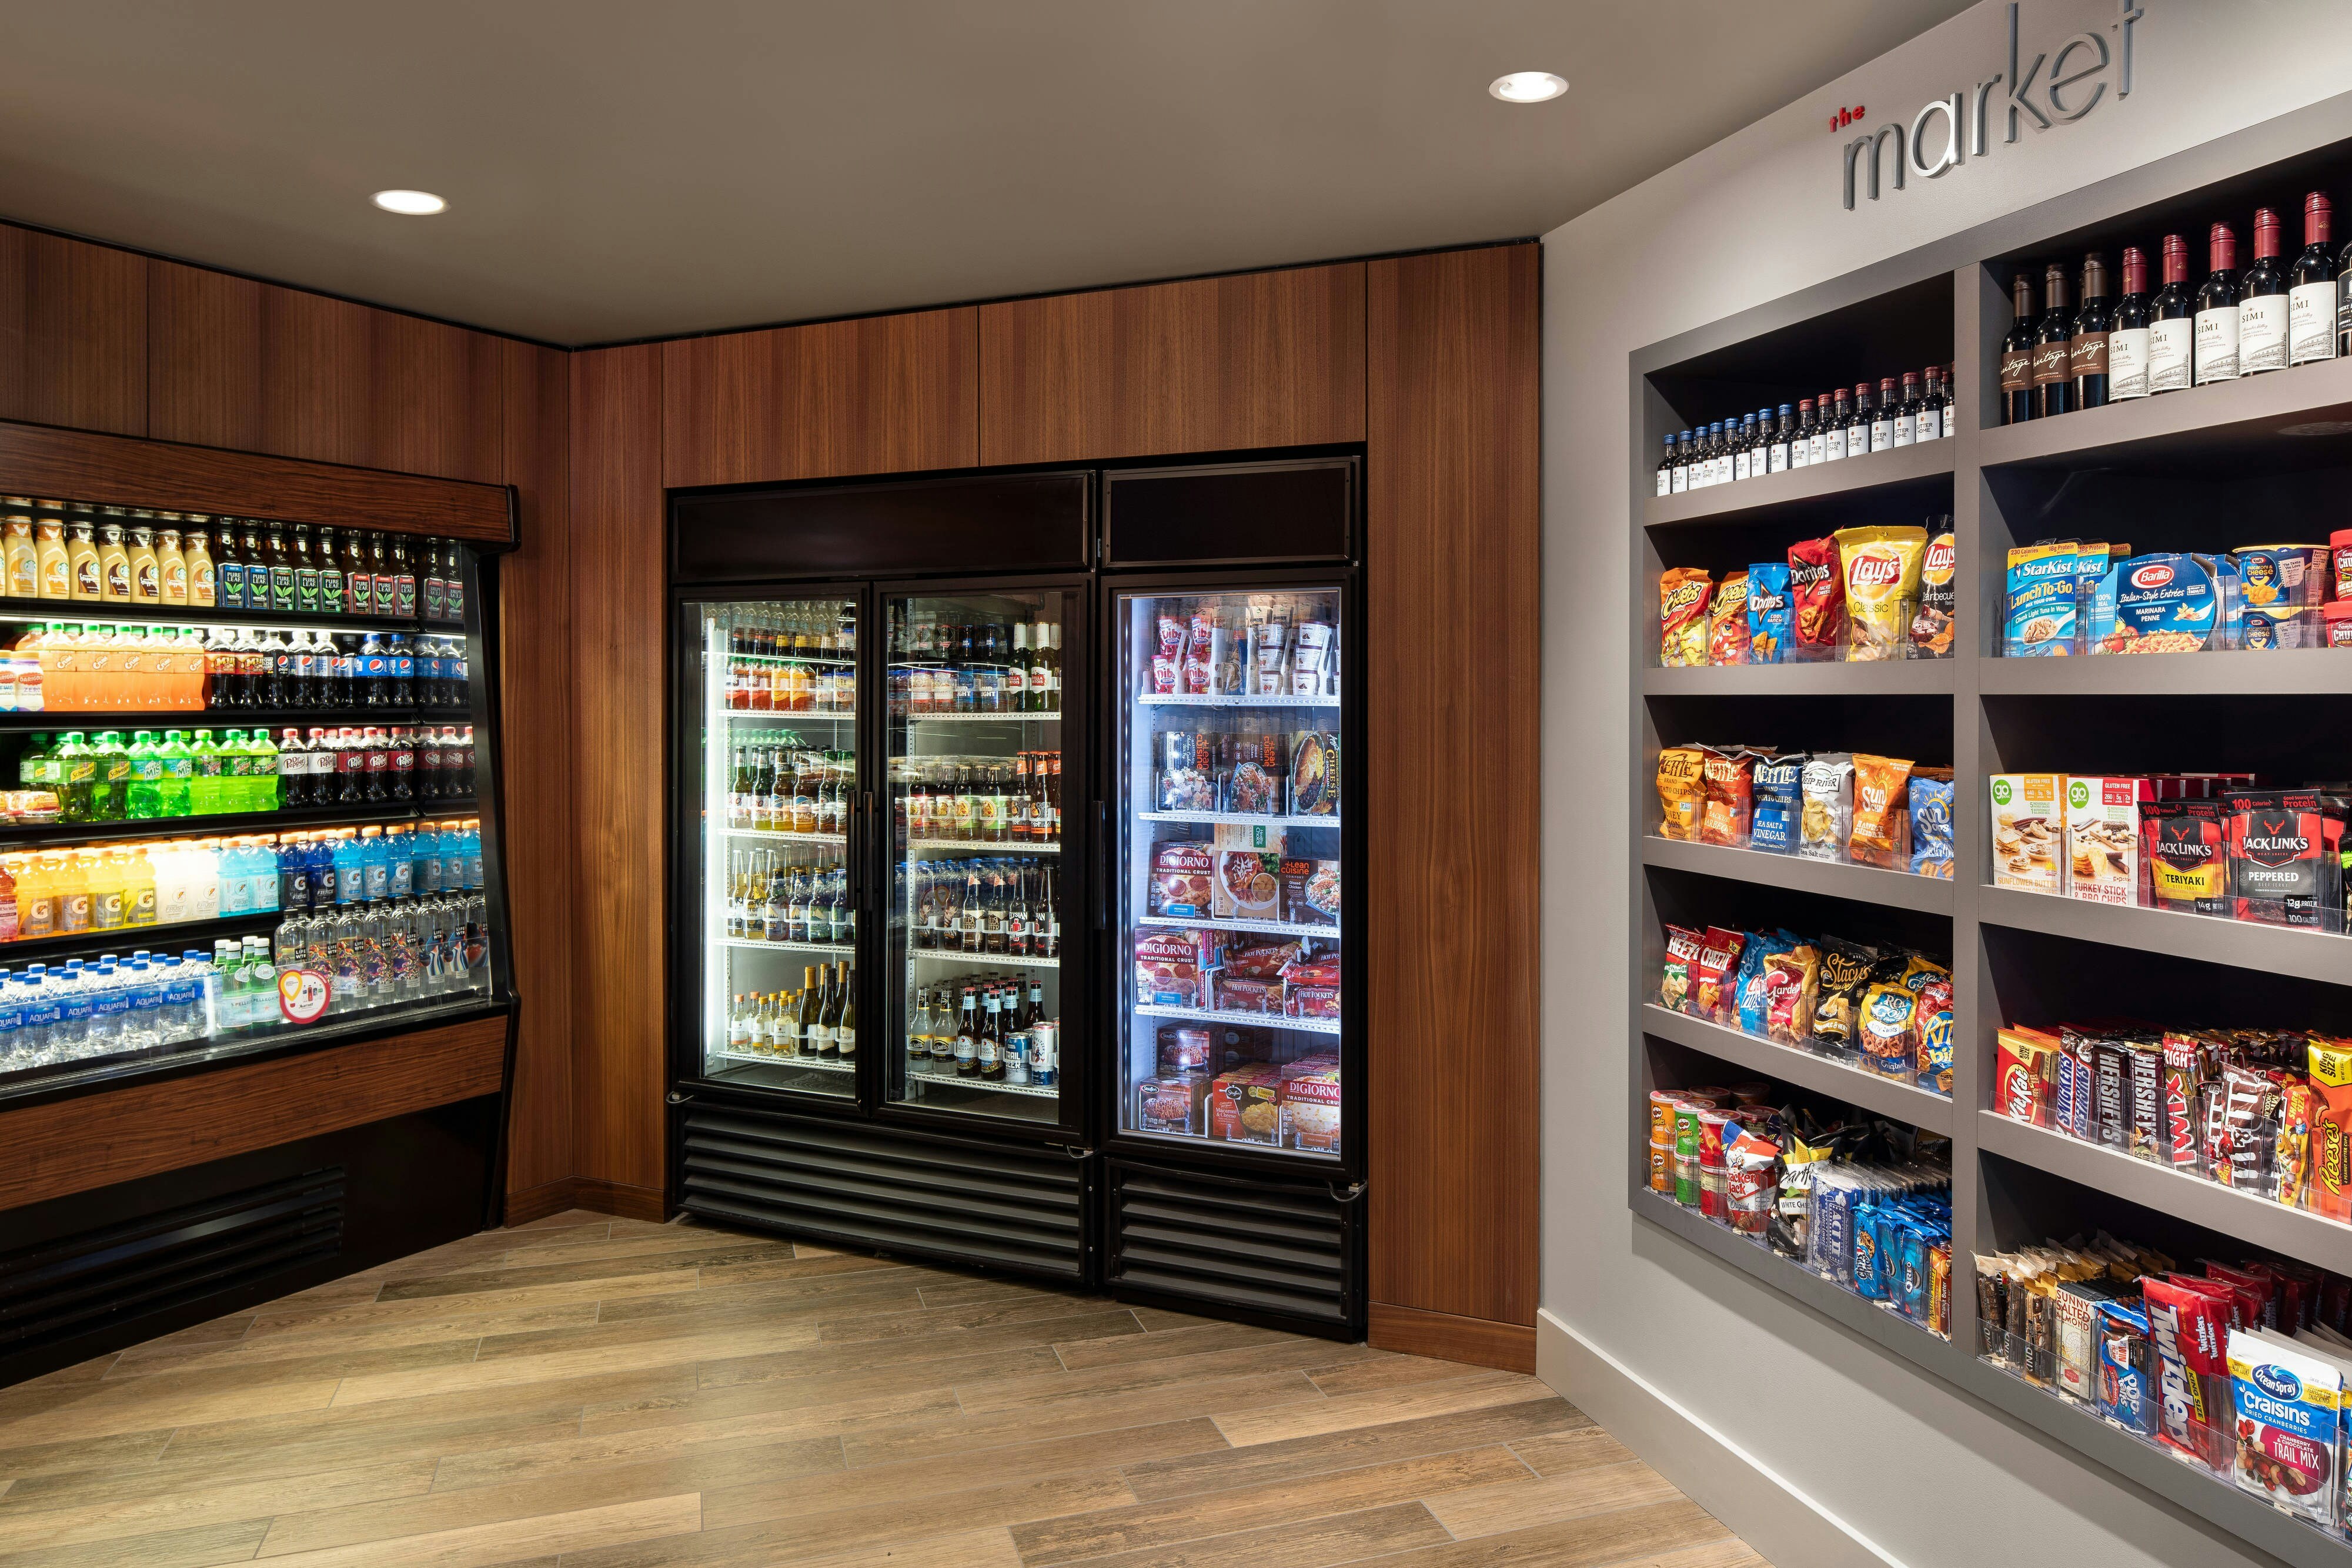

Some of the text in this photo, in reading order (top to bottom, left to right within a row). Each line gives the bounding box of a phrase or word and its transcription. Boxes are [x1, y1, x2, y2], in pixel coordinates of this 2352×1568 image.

[1843, 0, 2142, 210] market
[1829, 105, 1866, 133] the
[2242, 312, 2263, 323] SIMI
[2198, 323, 2218, 334] SIMI
[2110, 343, 2127, 354] SIMI
[1790, 564, 1830, 585] Doritos
[1851, 557, 1896, 586] Lay's
[2023, 559, 2073, 577] StarKist
[2140, 570, 2170, 583] Barilla
[1662, 581, 1703, 620] Cheetos
[1750, 595, 1783, 611] Doritos
[2010, 584, 2042, 610] Lunch
[2120, 588, 2185, 604] Italian-Style Entrées
[1853, 601, 1889, 613] Classic
[2136, 607, 2166, 615] MARINARA
[2016, 615, 2027, 624] Chunk
[1189, 667, 1208, 678] Dibs
[285, 758, 304, 768] Pepper
[1658, 753, 1693, 778] KETTLE
[1325, 749, 1336, 798] CHEESE
[1753, 762, 1797, 784] KETTLE
[1817, 778, 1836, 787] RIVER
[2232, 798, 2251, 810] 100
[2283, 800, 2317, 808] Protein
[1753, 828, 1786, 841] VINEGAR
[2156, 840, 2212, 857] JACK LINK'S
[2243, 837, 2308, 851] JACK LINK'S
[1997, 877, 2057, 888] SUNFLOWER BUTTER
[2166, 874, 2204, 885] TERIYAKI
[2249, 871, 2299, 882] PEPPERED
[2074, 882, 2126, 896] TURKEY STICK
[1255, 947, 1278, 956] POCKETS
[1820, 953, 1871, 991] Stacy's
[2173, 1043, 2189, 1052] FOUR
[2320, 1052, 2329, 1075] KING
[2327, 1057, 2336, 1078] SIZE
[2058, 1050, 2072, 1126] SNICKERS
[2288, 1091, 2298, 1120] SHARE
[2297, 1095, 2305, 1115] SIZE
[2166, 1074, 2197, 1170] TWIX
[2318, 1118, 2340, 1195] Reese's
[1728, 1180, 1746, 1195] Jack
[1905, 1262, 1913, 1293] OREO
[2057, 1289, 2090, 1311] SUNNY
[2057, 1300, 2091, 1323] SALTED
[2056, 1312, 2089, 1331] ALMOND
[2197, 1315, 2209, 1354] Twizzlers
[2118, 1345, 2127, 1363] WIN
[2110, 1369, 2118, 1402] Strawberry
[2255, 1369, 2296, 1396] Ocean Spray
[2118, 1376, 2127, 1410] tarts
[2189, 1370, 2203, 1419] KING SIZE
[2308, 1393, 2330, 1405] SNACKING!
[2245, 1409, 2307, 1434] DRIED CRANBERRIES
[2279, 1434, 2311, 1447] CRANBERRY
[2281, 1440, 2314, 1453] CHOCOLATE
[2273, 1441, 2319, 1470] TRAIL MIX
